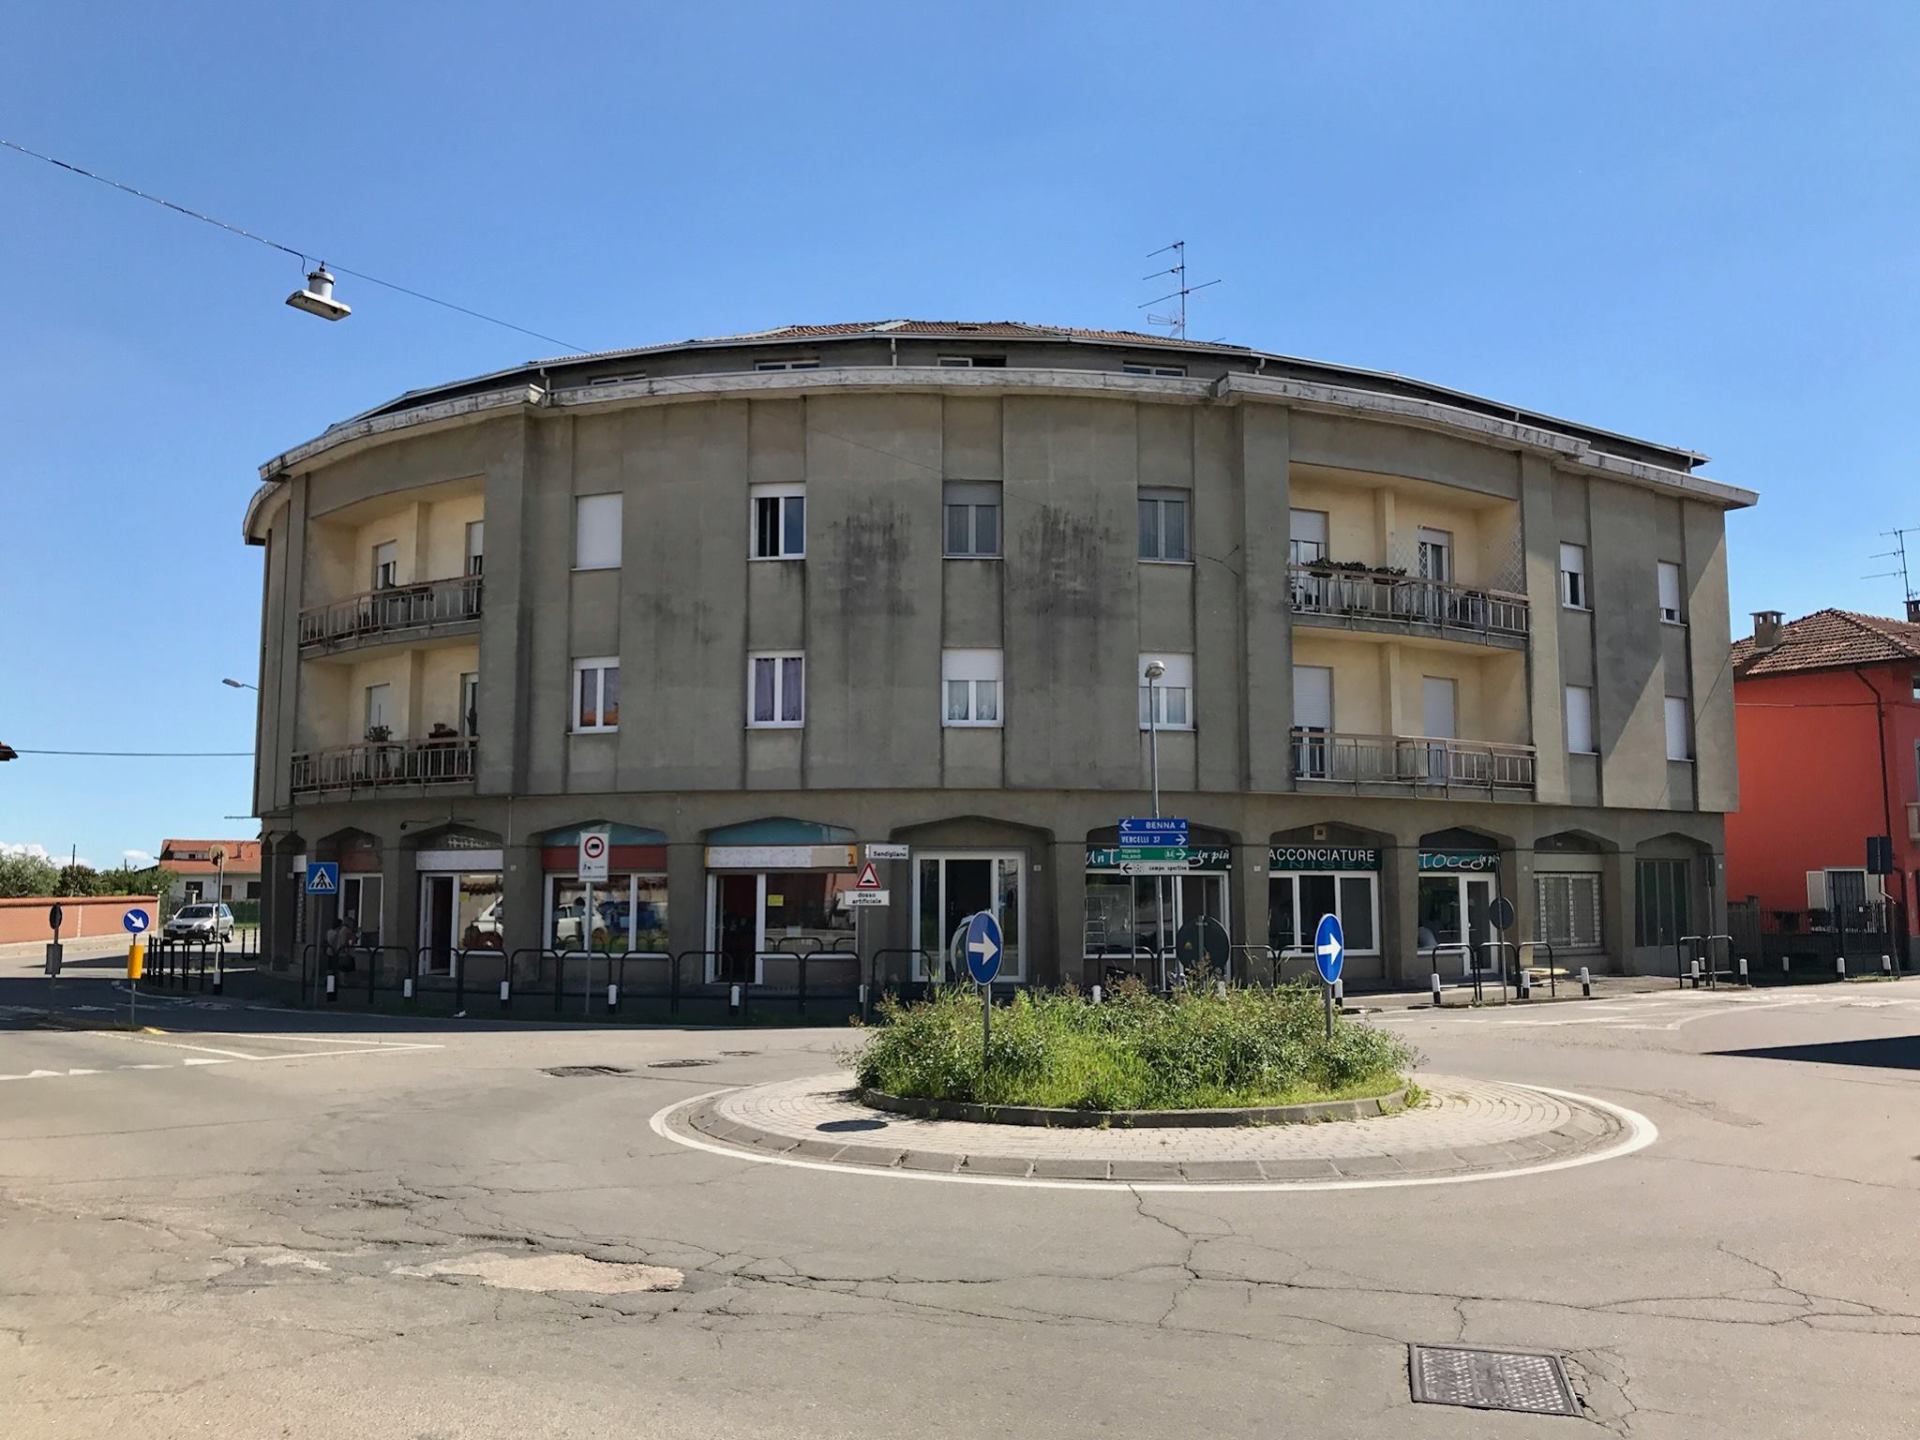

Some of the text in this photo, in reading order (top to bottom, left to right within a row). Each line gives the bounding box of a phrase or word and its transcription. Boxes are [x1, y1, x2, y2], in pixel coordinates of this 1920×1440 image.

[1145, 821, 1186, 829] BENNA 4
[1269, 848, 1375, 861] ACCONCIATURE
